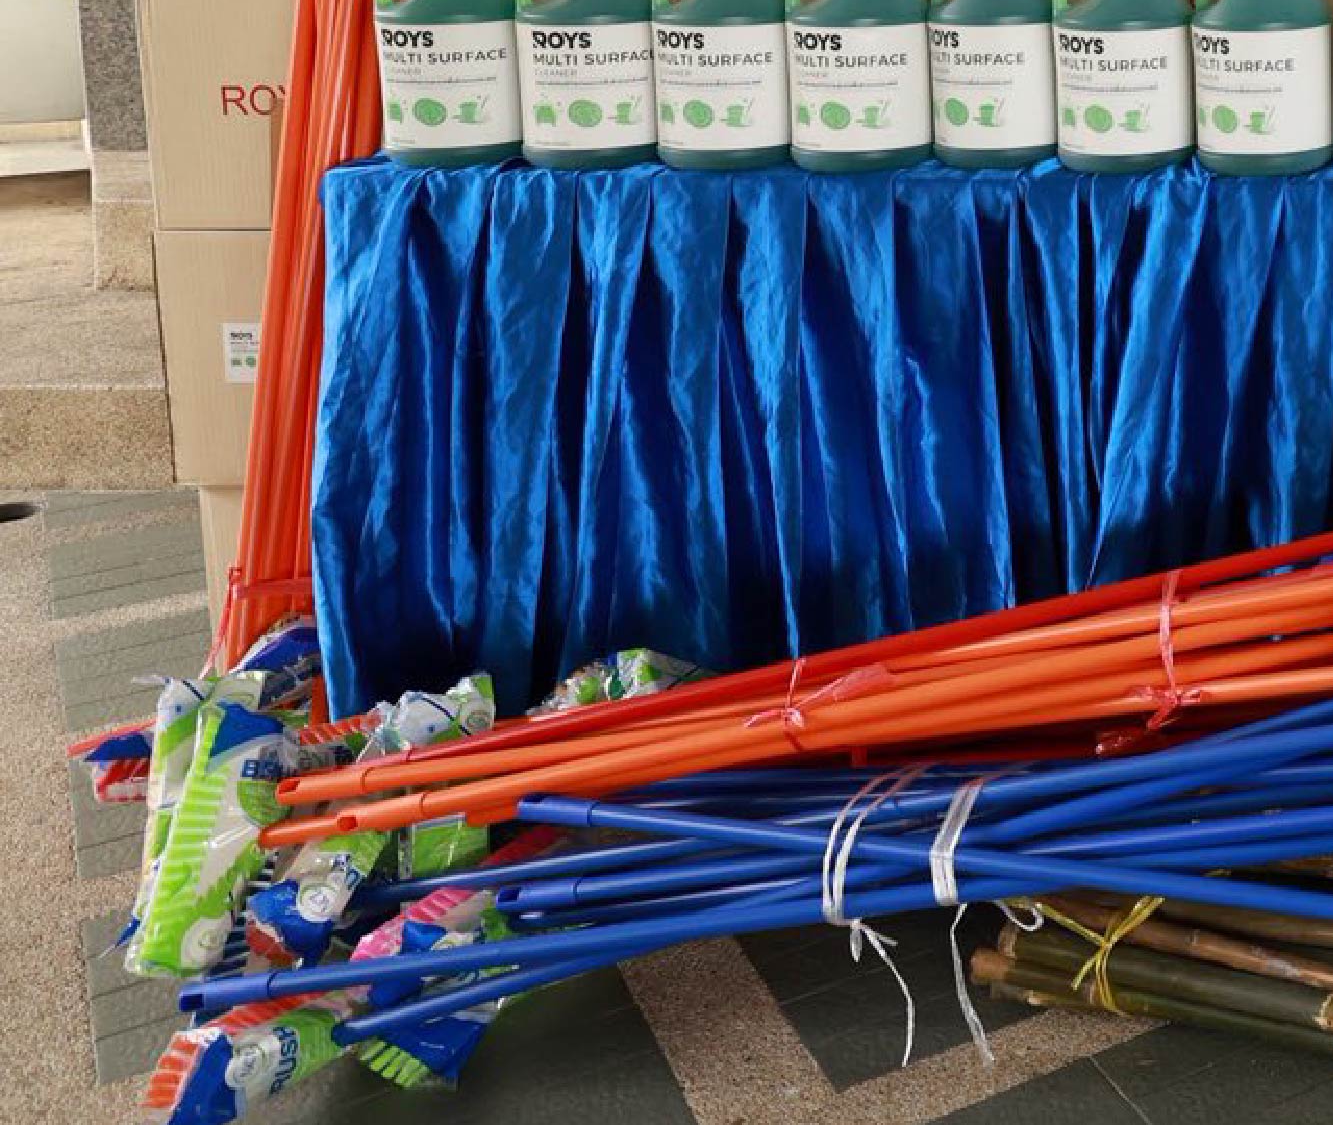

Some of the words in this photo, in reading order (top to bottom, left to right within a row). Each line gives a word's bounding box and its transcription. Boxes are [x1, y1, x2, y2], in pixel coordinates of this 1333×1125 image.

[381, 29, 434, 48] ROYS
[532, 31, 592, 49] ROYS
[656, 30, 705, 50] ROYS
[428, 48, 508, 63] SURFACE
[533, 53, 578, 66] MULTI
[697, 52, 773, 68] SURFACE
[834, 53, 908, 68] SURFACE
[953, 52, 1025, 66] SURFACE
[1099, 56, 1168, 72] SURFACE
[1224, 58, 1294, 72] SURFACE
[220, 84, 286, 115] RO
